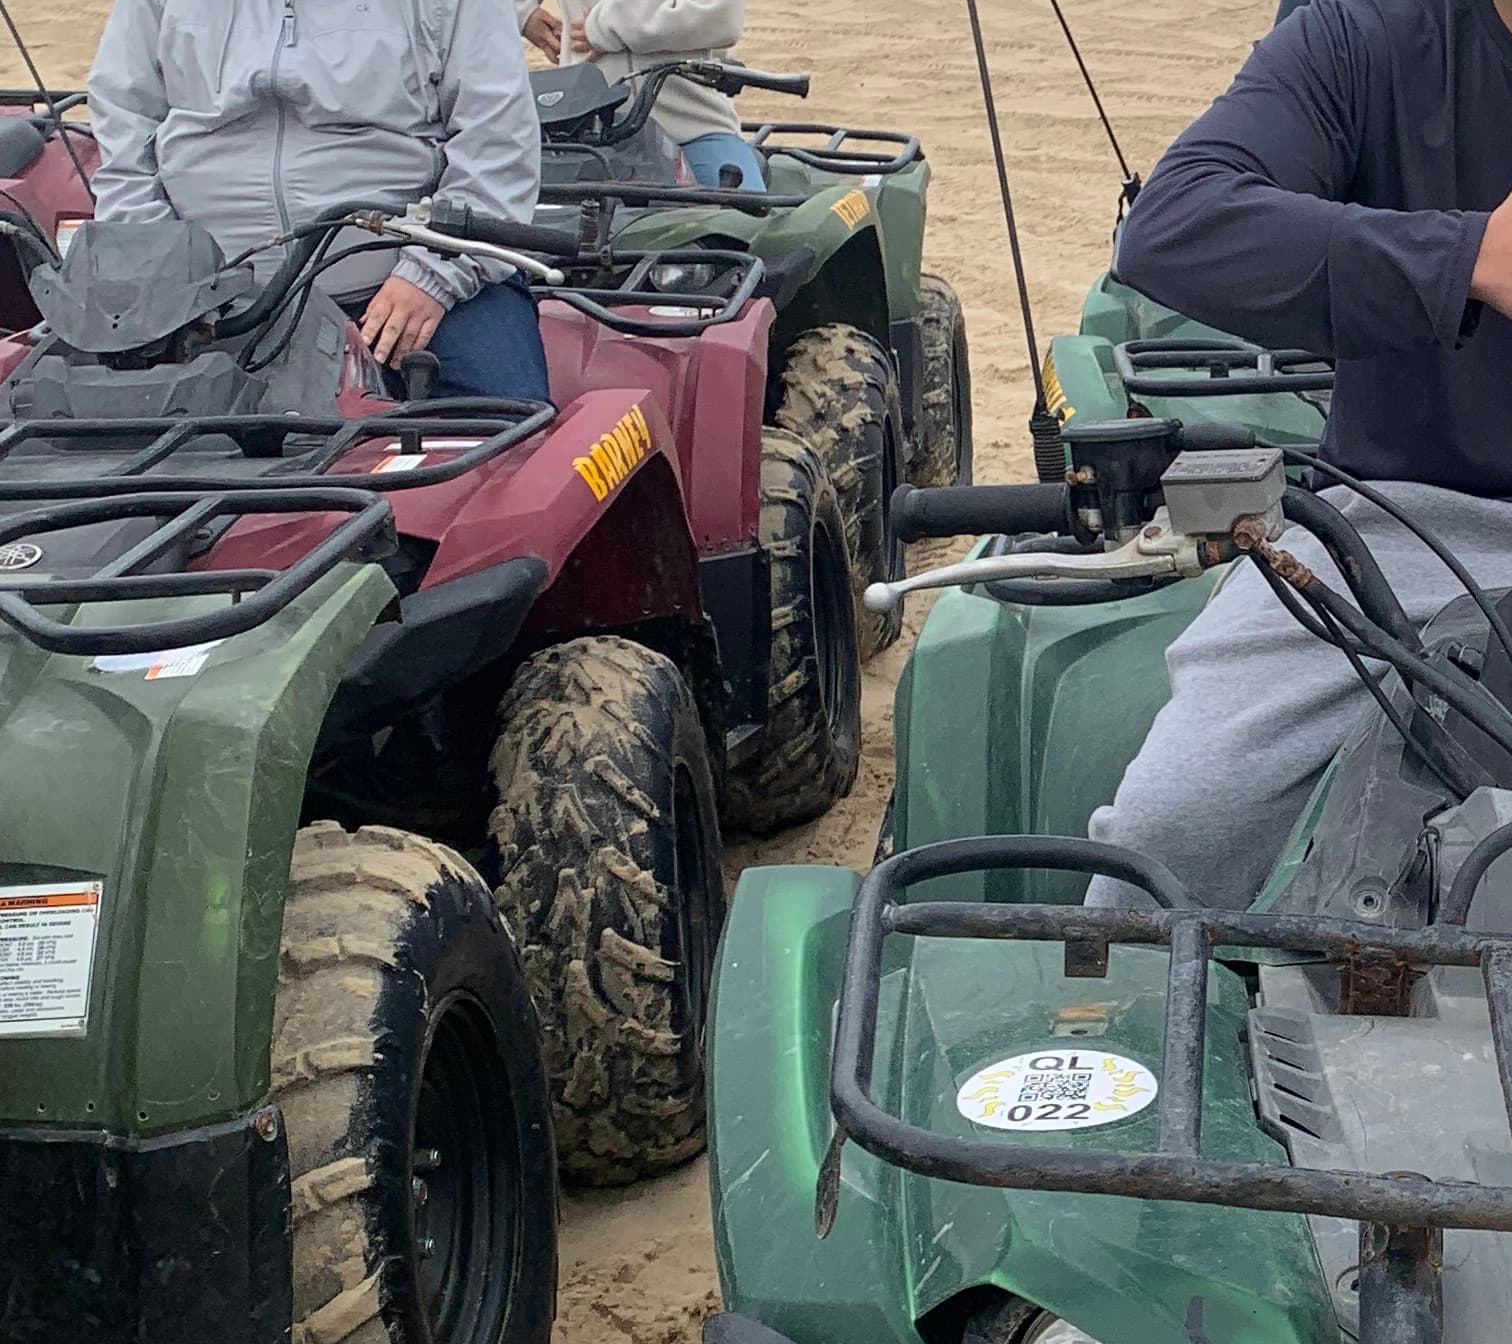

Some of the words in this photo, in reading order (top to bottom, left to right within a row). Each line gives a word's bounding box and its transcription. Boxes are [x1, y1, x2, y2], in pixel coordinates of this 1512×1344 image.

[572, 404, 652, 502] BARNEY
[1029, 1056, 1094, 1071] QL
[1007, 1104, 1091, 1122] 022
